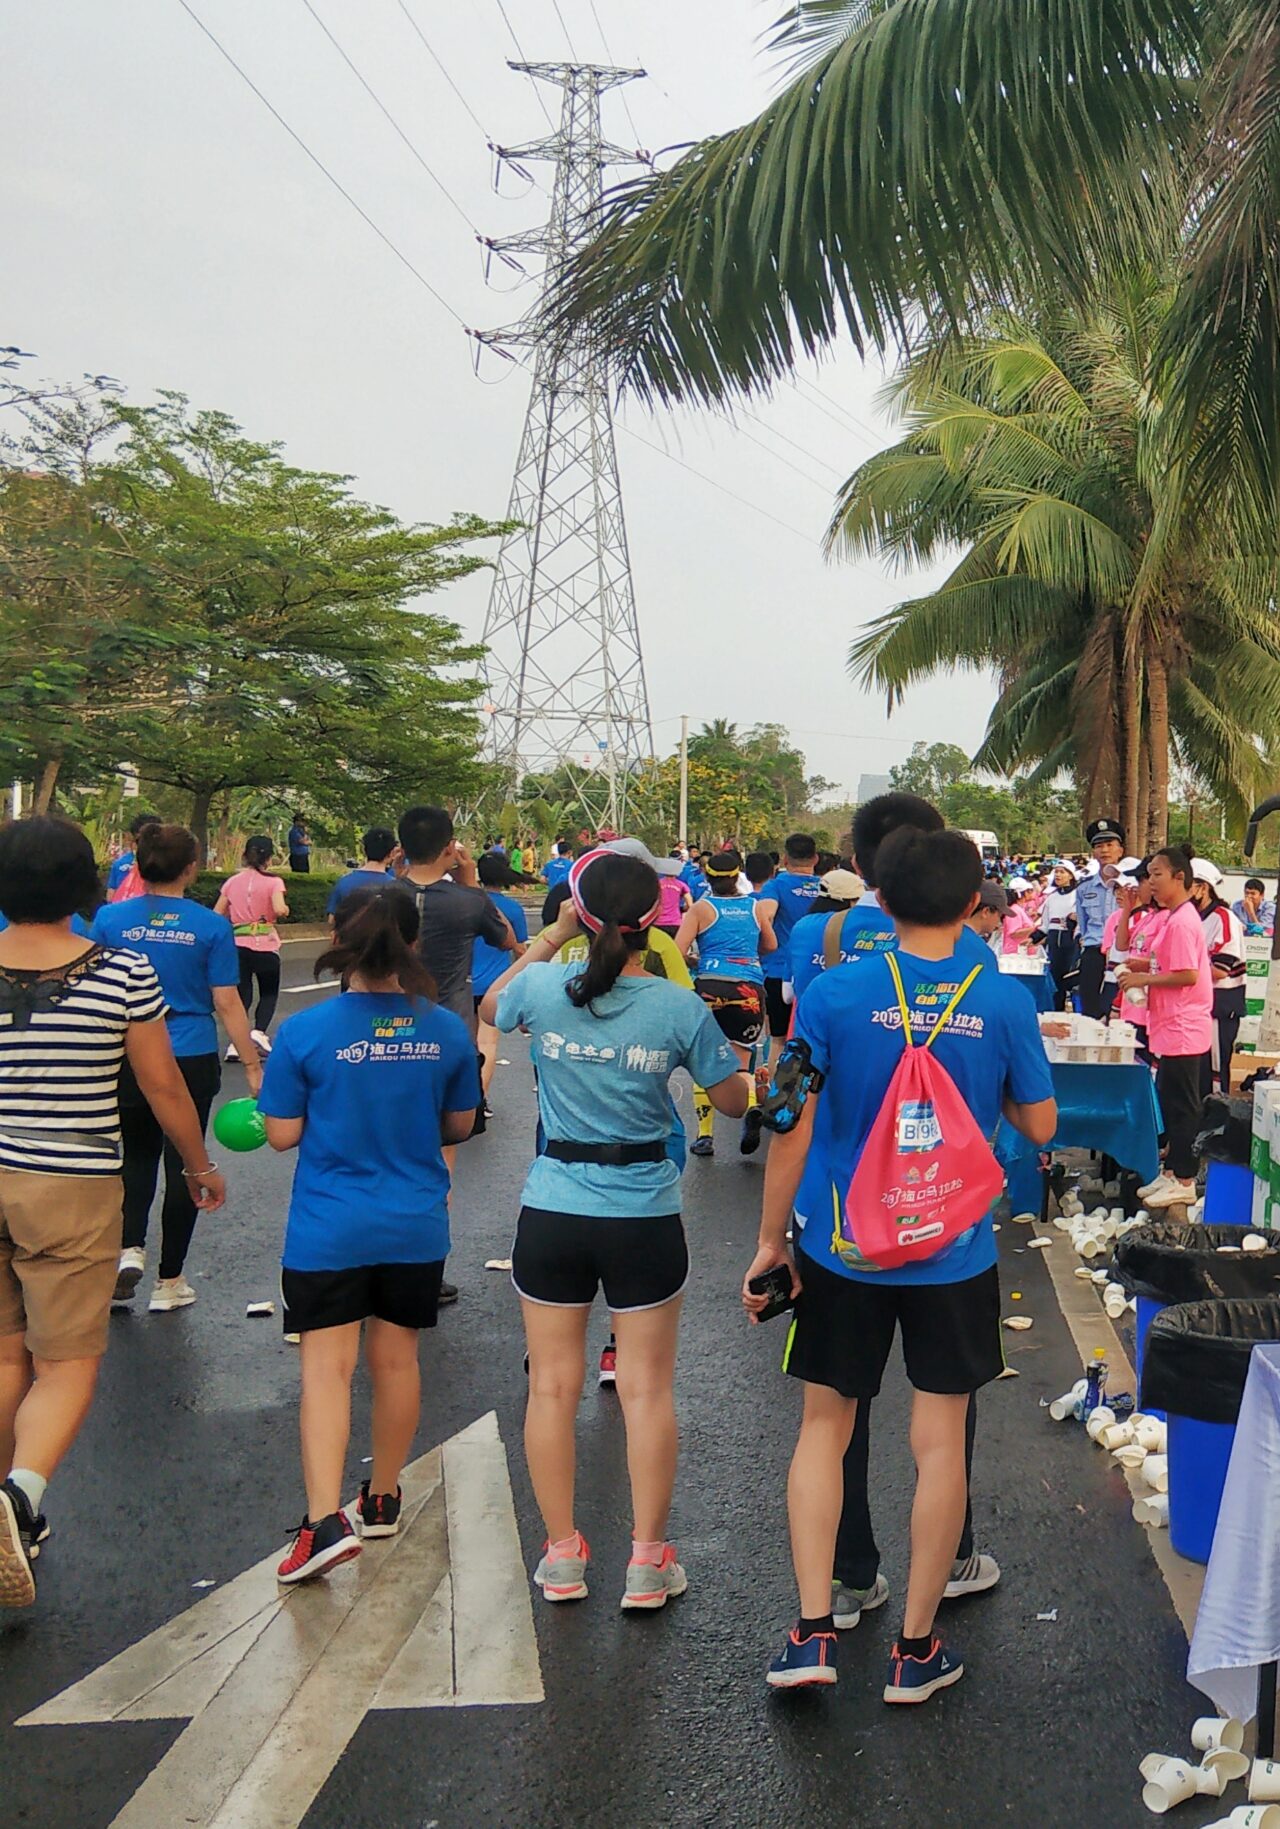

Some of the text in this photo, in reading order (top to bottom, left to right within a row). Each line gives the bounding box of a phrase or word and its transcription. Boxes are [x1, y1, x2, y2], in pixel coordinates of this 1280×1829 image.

[871, 1011, 901, 1024] 2019
[336, 1042, 441, 1060] 2019 海口马拉松
